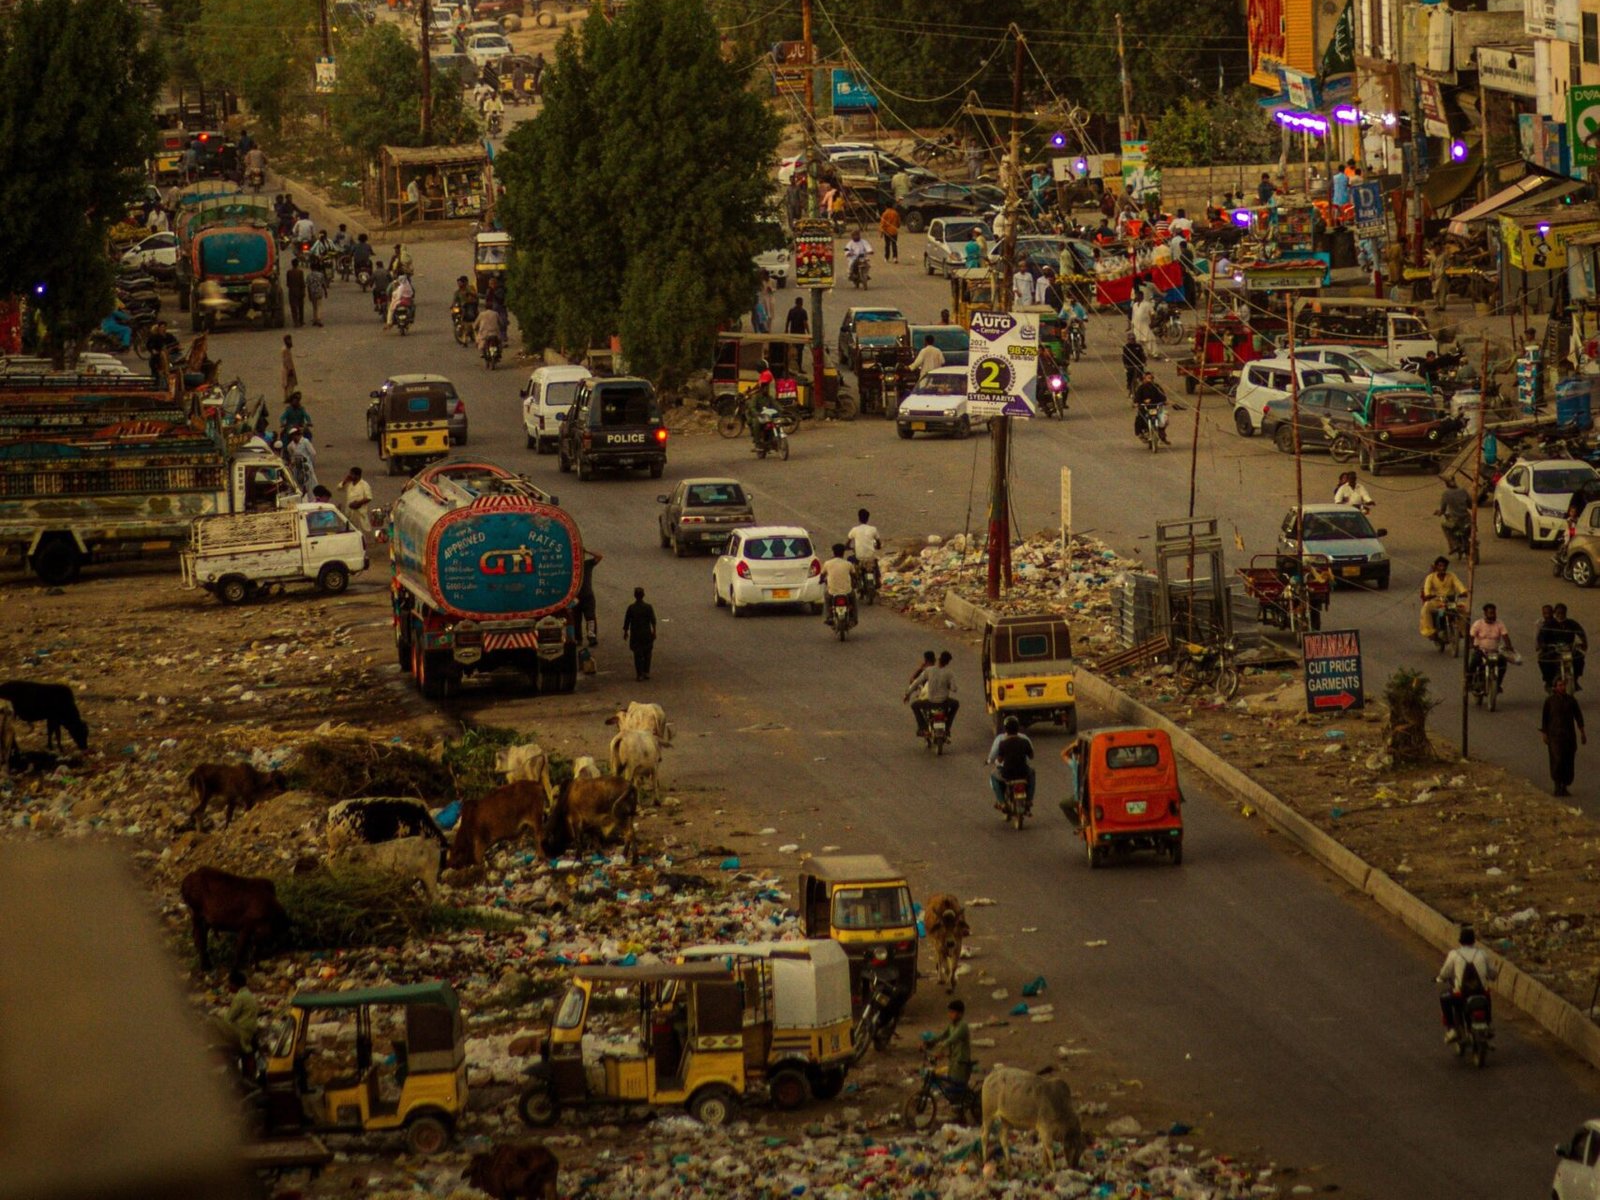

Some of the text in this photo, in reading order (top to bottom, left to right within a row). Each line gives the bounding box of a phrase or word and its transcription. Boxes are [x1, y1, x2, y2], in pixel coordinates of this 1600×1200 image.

[971, 312, 1011, 329] Aura
[607, 433, 646, 444] POLICE
[444, 530, 564, 560] APPROVED RATES
[1308, 659, 1357, 675] CUT PRICE
[1308, 675, 1360, 692] GARMENTS
